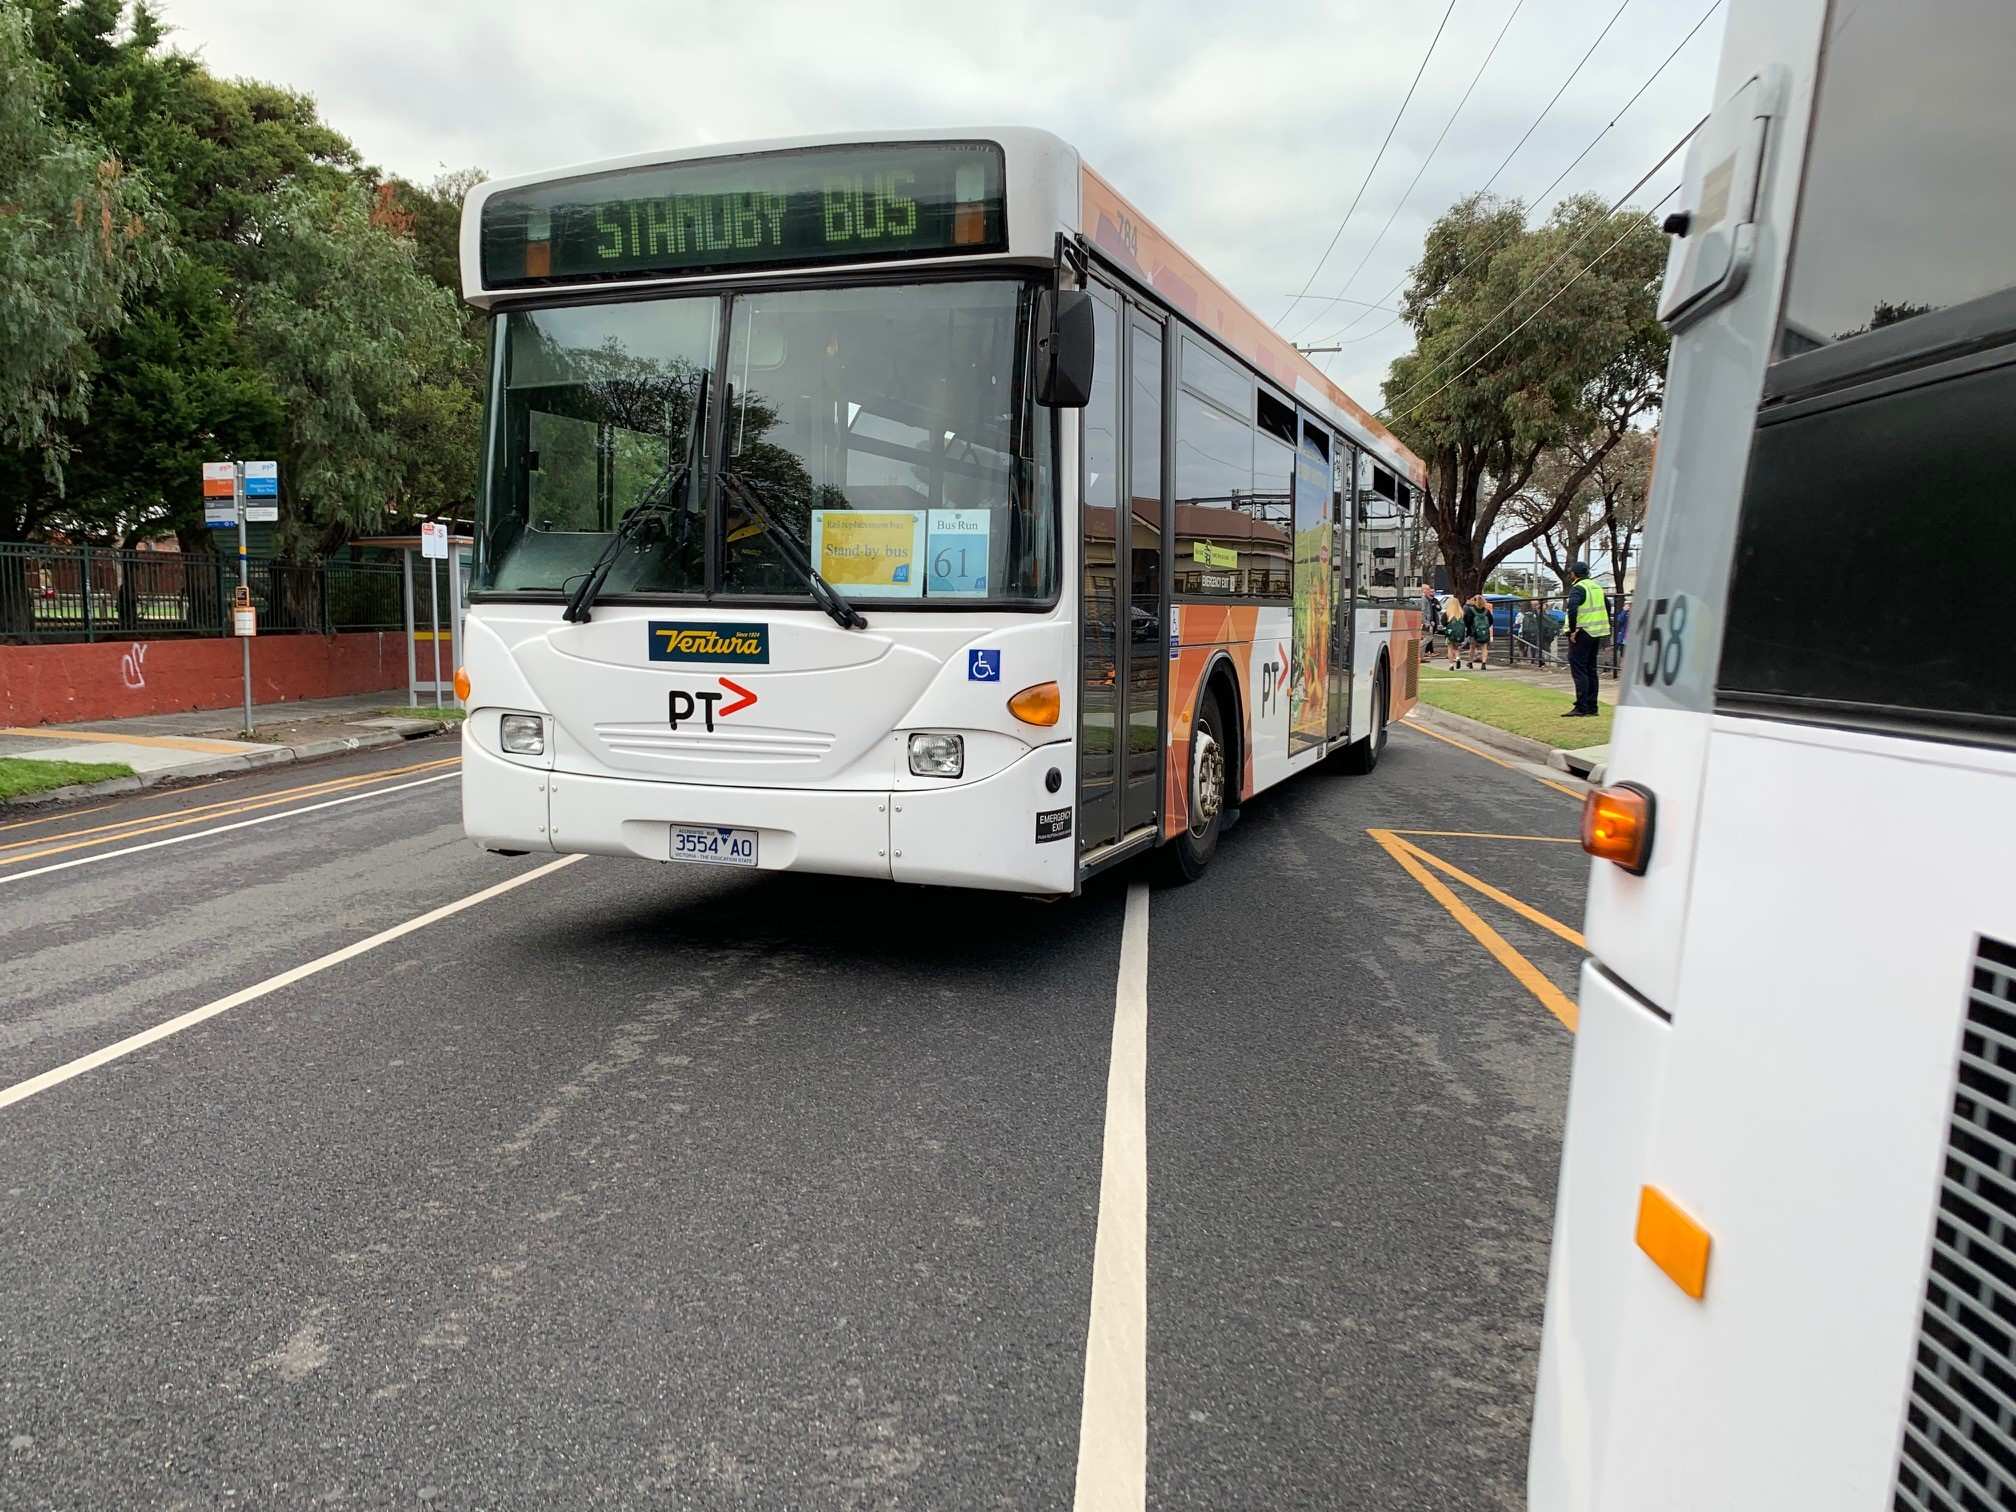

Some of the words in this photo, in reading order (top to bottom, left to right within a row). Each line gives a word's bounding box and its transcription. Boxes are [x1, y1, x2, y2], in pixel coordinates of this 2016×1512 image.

[824, 170, 916, 241] BUS
[937, 520, 957, 530] Bus
[958, 520, 979, 530] Run
[886, 544, 909, 557] bus
[934, 546, 969, 578] 61
[656, 629, 763, 655] Ventura
[1636, 594, 1687, 687] 158
[1040, 811, 1070, 824] EMERGENCY
[1052, 821, 1064, 832] EXIT
[675, 834, 718, 854] 3554
[730, 838, 752, 857] AO
